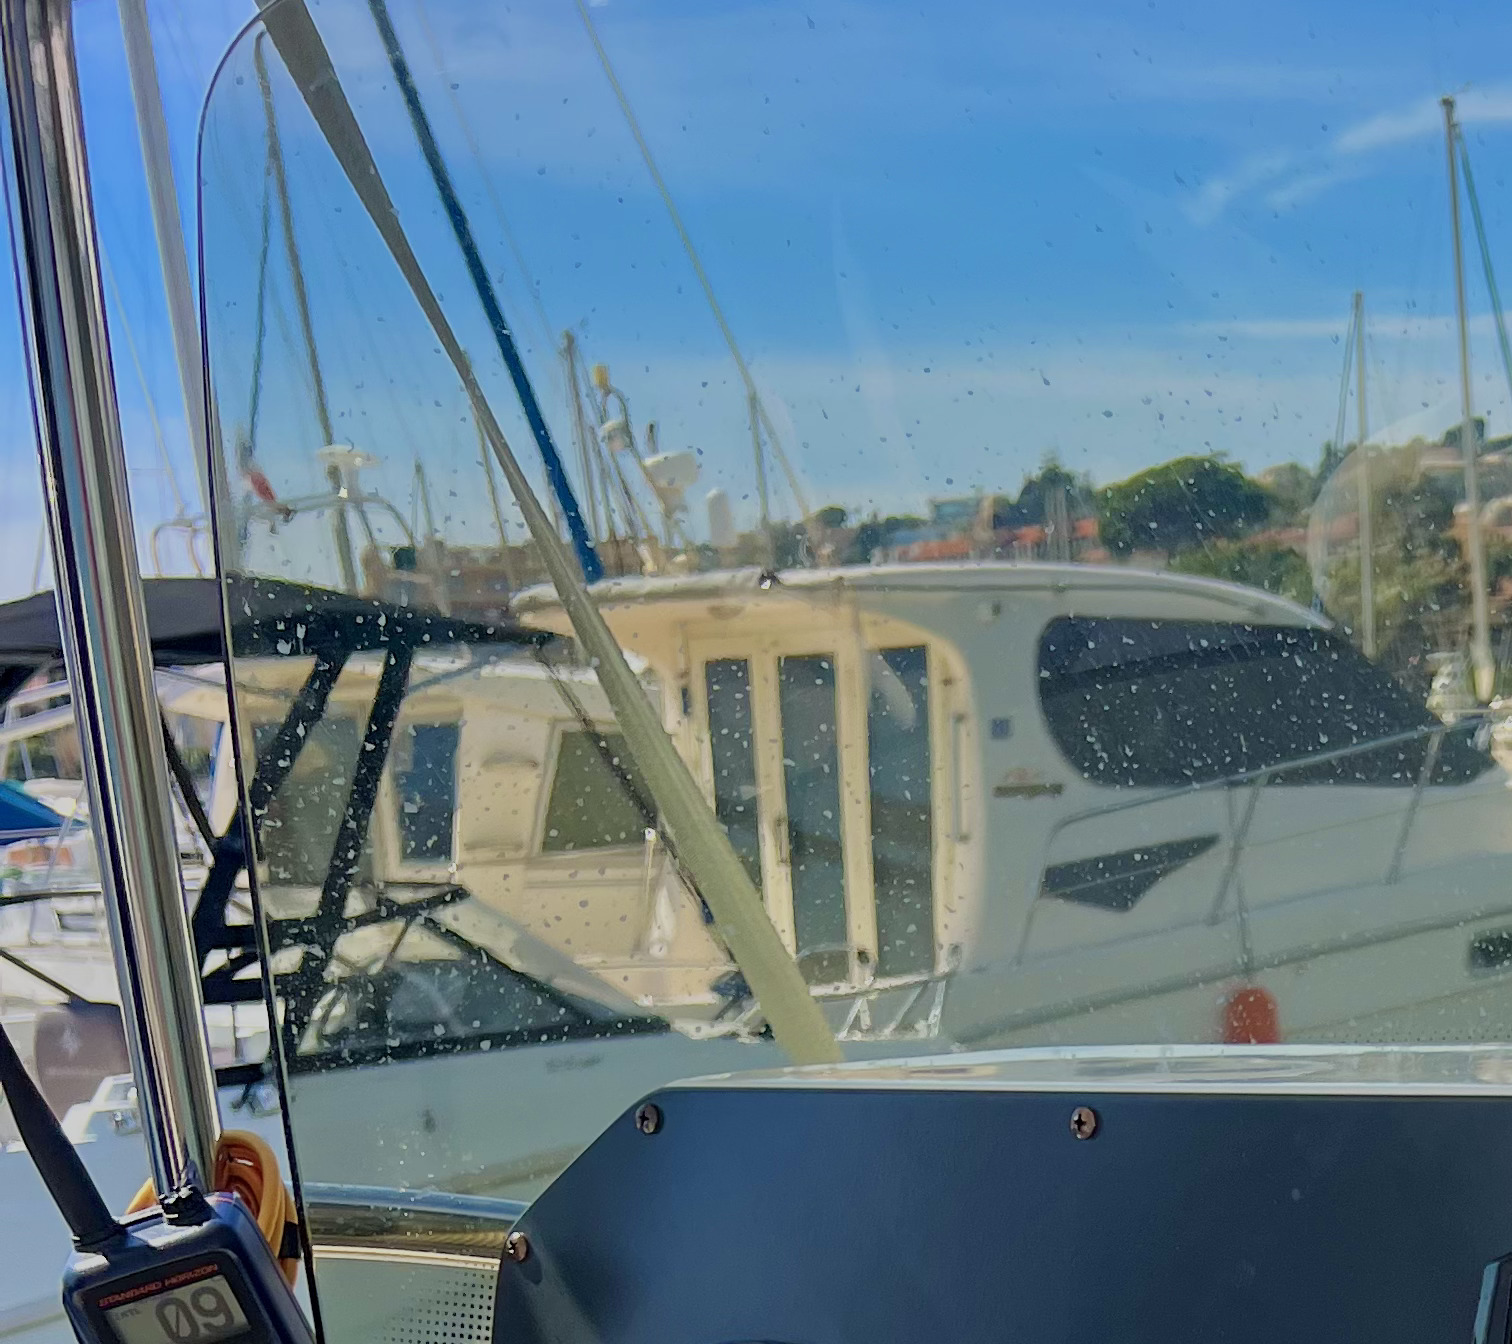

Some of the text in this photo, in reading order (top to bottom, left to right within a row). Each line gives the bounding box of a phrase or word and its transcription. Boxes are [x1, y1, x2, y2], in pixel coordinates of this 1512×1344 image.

[99, 1264, 218, 1307] STANDARD HORIZON
[156, 1286, 235, 1344] 09
